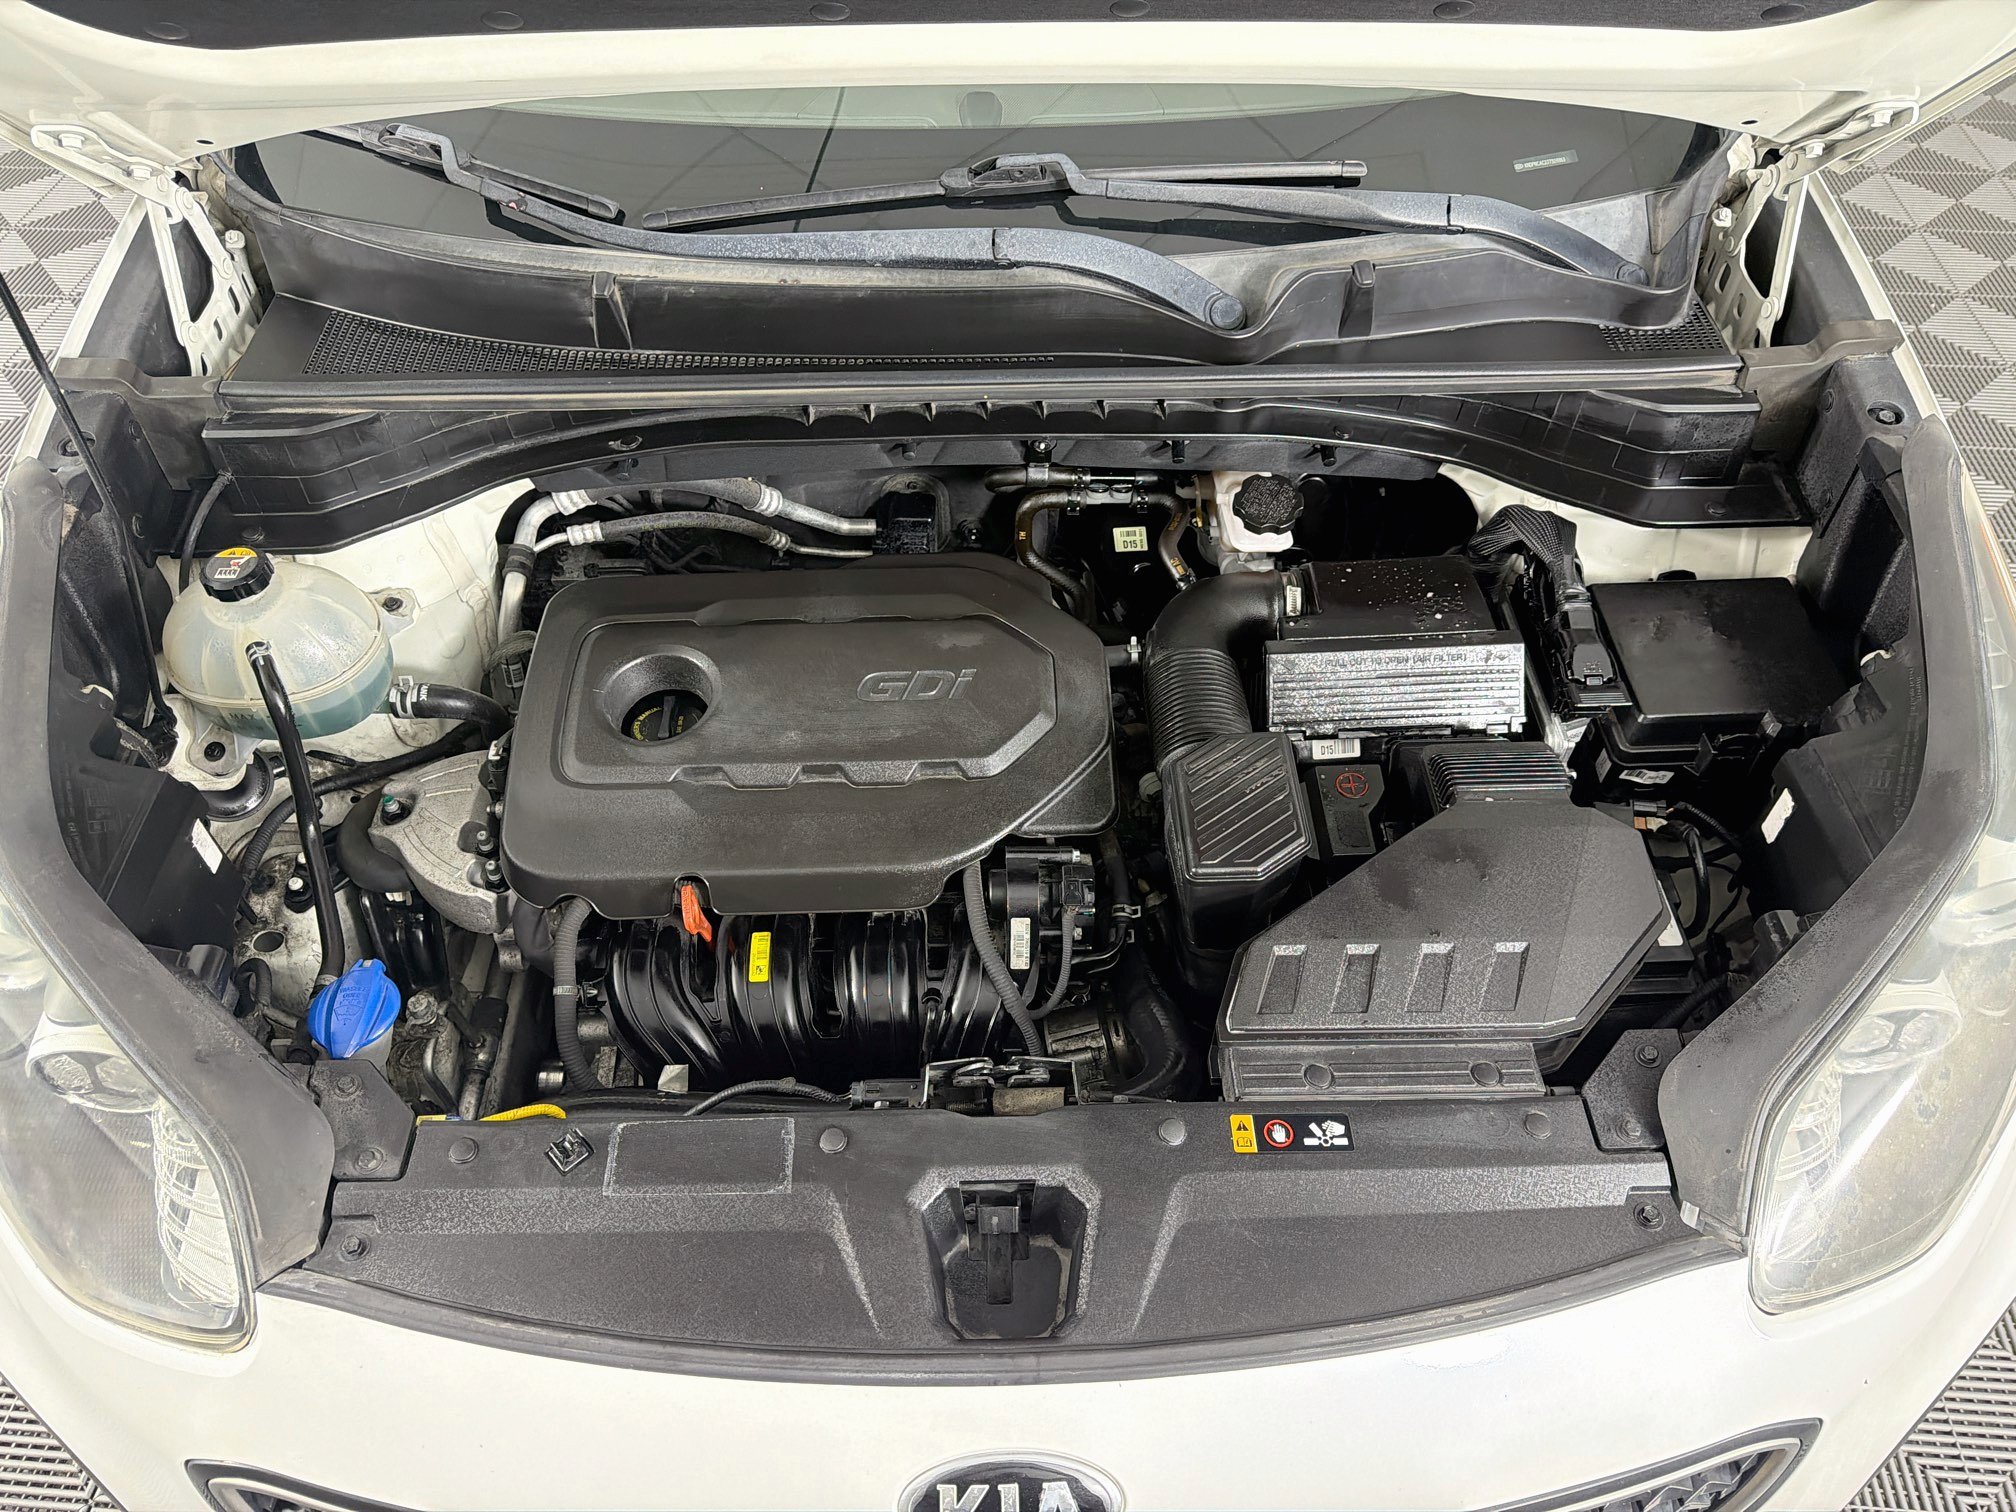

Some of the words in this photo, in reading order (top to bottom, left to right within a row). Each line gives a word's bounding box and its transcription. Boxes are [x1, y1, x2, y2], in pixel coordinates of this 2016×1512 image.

[1122, 540, 1138, 549] D15
[1383, 655, 1409, 665] OPEN
[856, 668, 977, 702] GDi
[1320, 745, 1334, 756] D15
